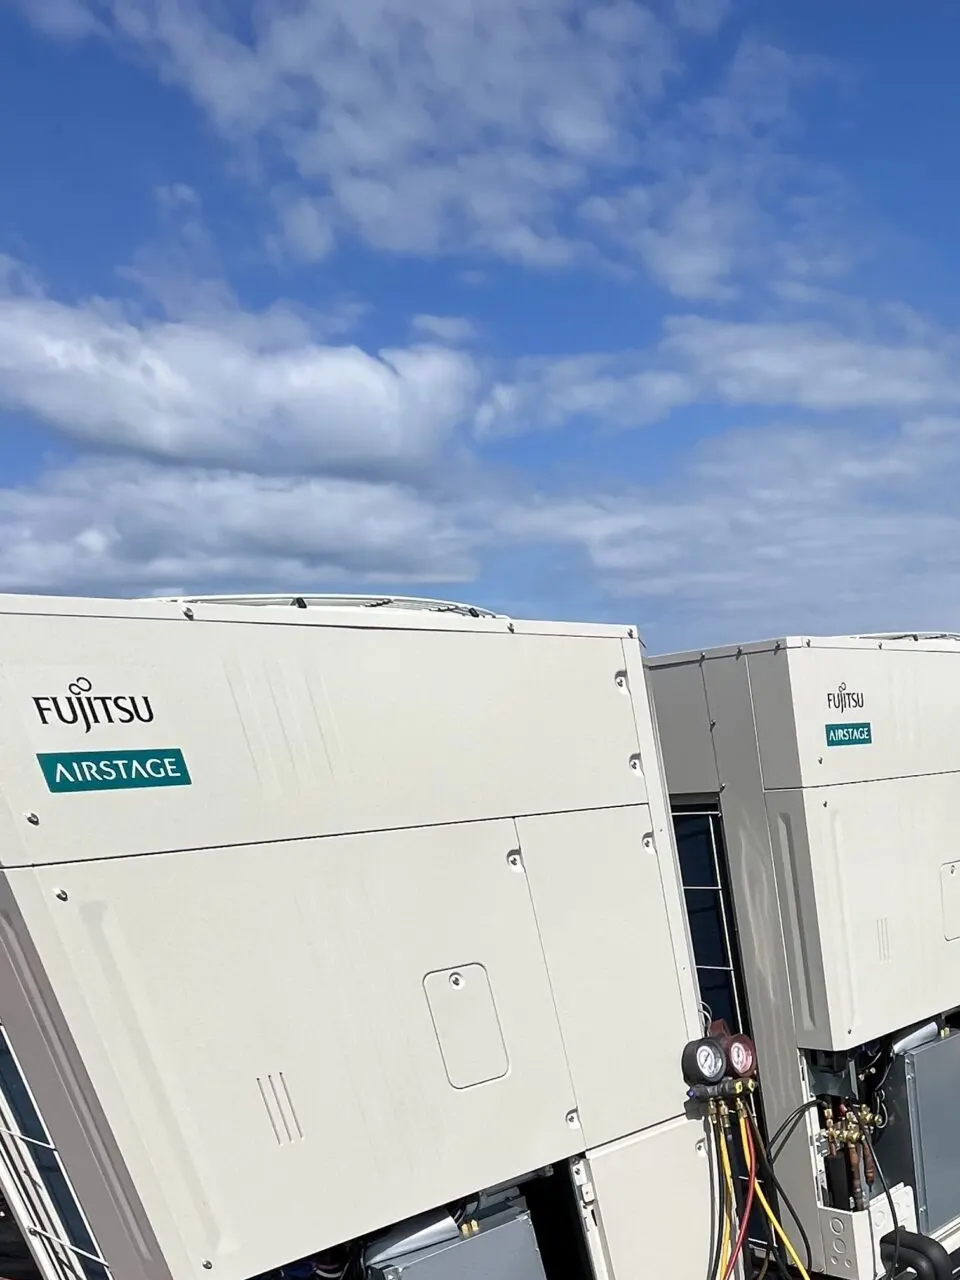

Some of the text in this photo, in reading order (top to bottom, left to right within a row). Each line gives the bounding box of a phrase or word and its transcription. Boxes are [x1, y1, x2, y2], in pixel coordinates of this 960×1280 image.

[32, 695, 154, 733] FUJITSU
[827, 692, 864, 713] FUJITSU
[829, 728, 869, 741] AIRSTAGE
[55, 758, 182, 783] AIRSTAGE
